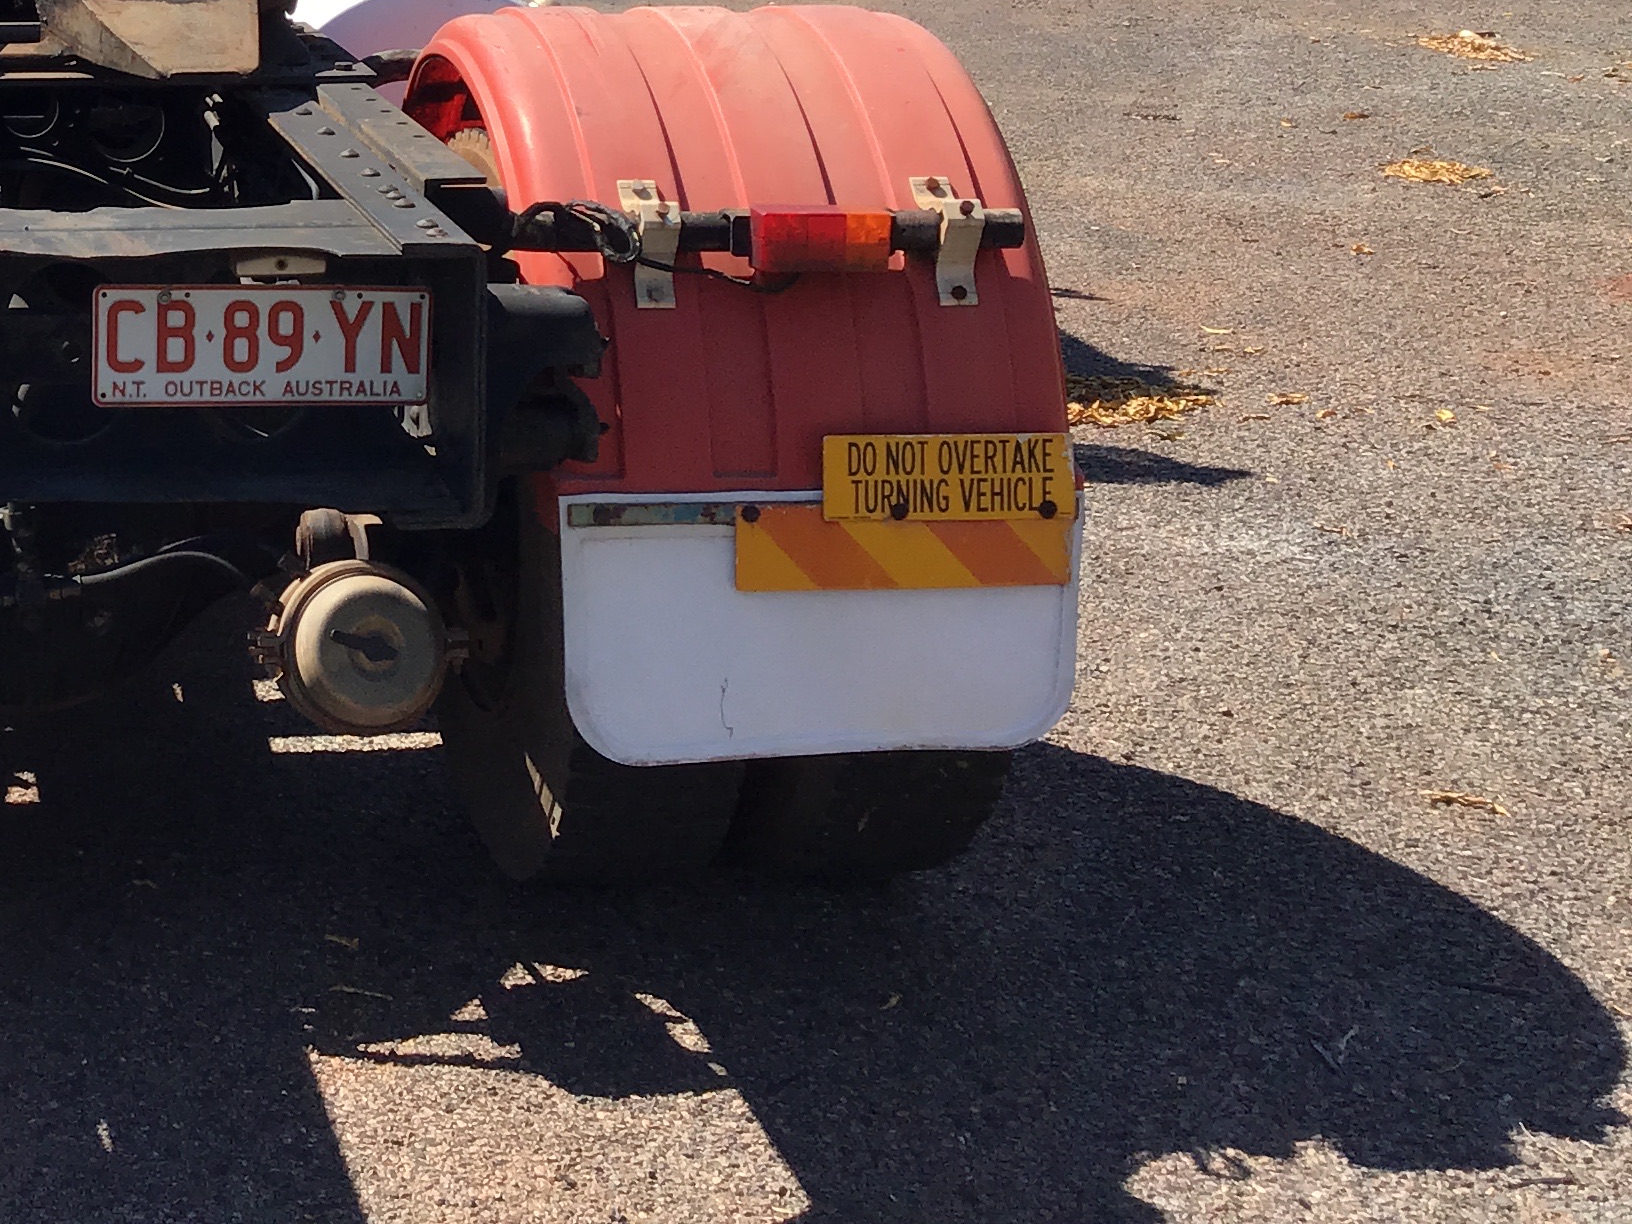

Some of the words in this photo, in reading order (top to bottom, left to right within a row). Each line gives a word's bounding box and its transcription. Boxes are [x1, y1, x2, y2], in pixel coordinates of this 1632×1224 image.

[112, 381, 147, 398] N.T.
[165, 381, 266, 398] OUTBACK
[282, 380, 402, 398] AUSTRALIA
[848, 442, 877, 476] DO
[885, 440, 928, 476] NOT
[938, 438, 1055, 475] OVERTAKE
[851, 479, 950, 514] TURNING
[959, 476, 1054, 513] VEHICLE
